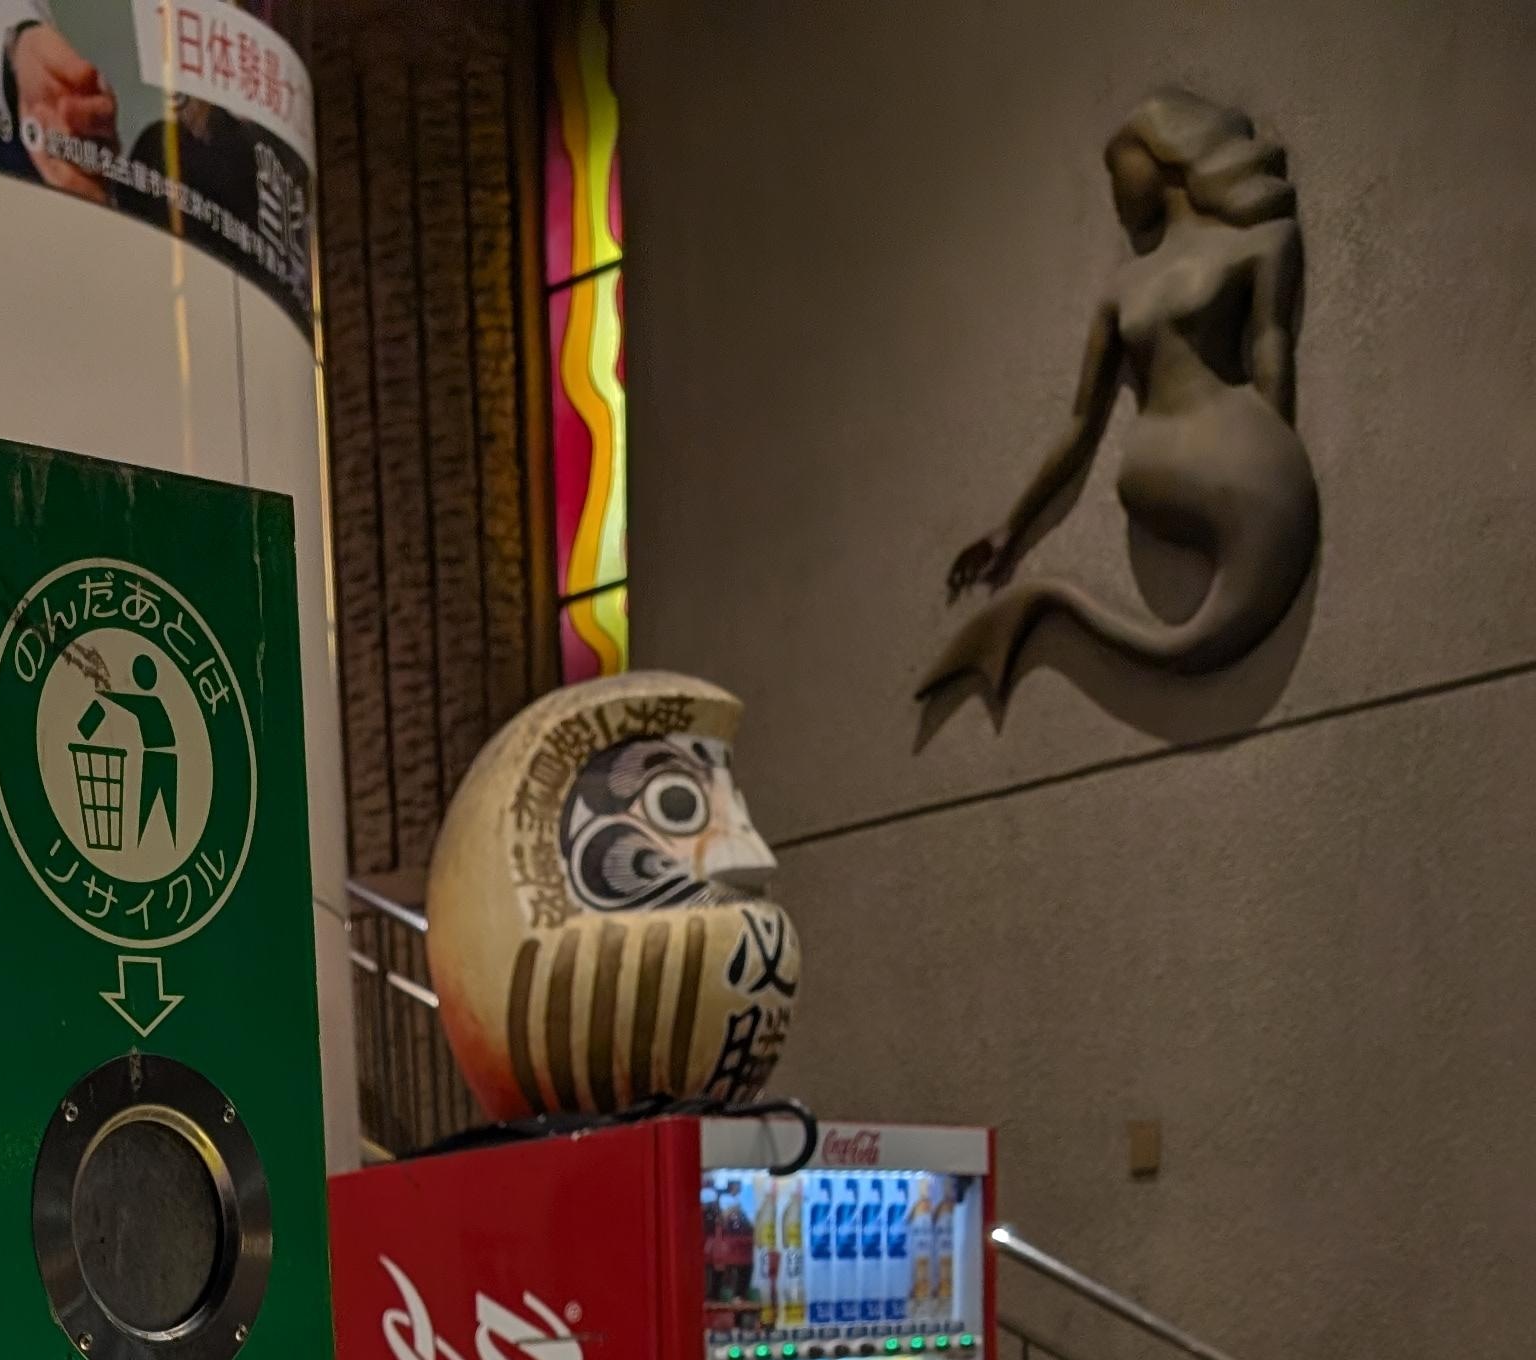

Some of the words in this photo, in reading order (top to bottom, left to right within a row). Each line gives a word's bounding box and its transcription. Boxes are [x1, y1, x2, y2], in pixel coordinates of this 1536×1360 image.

[14, 571, 230, 716] のんだあとは
[44, 838, 226, 931] リサイクル
[821, 1128, 882, 1167] Coca-Cola
